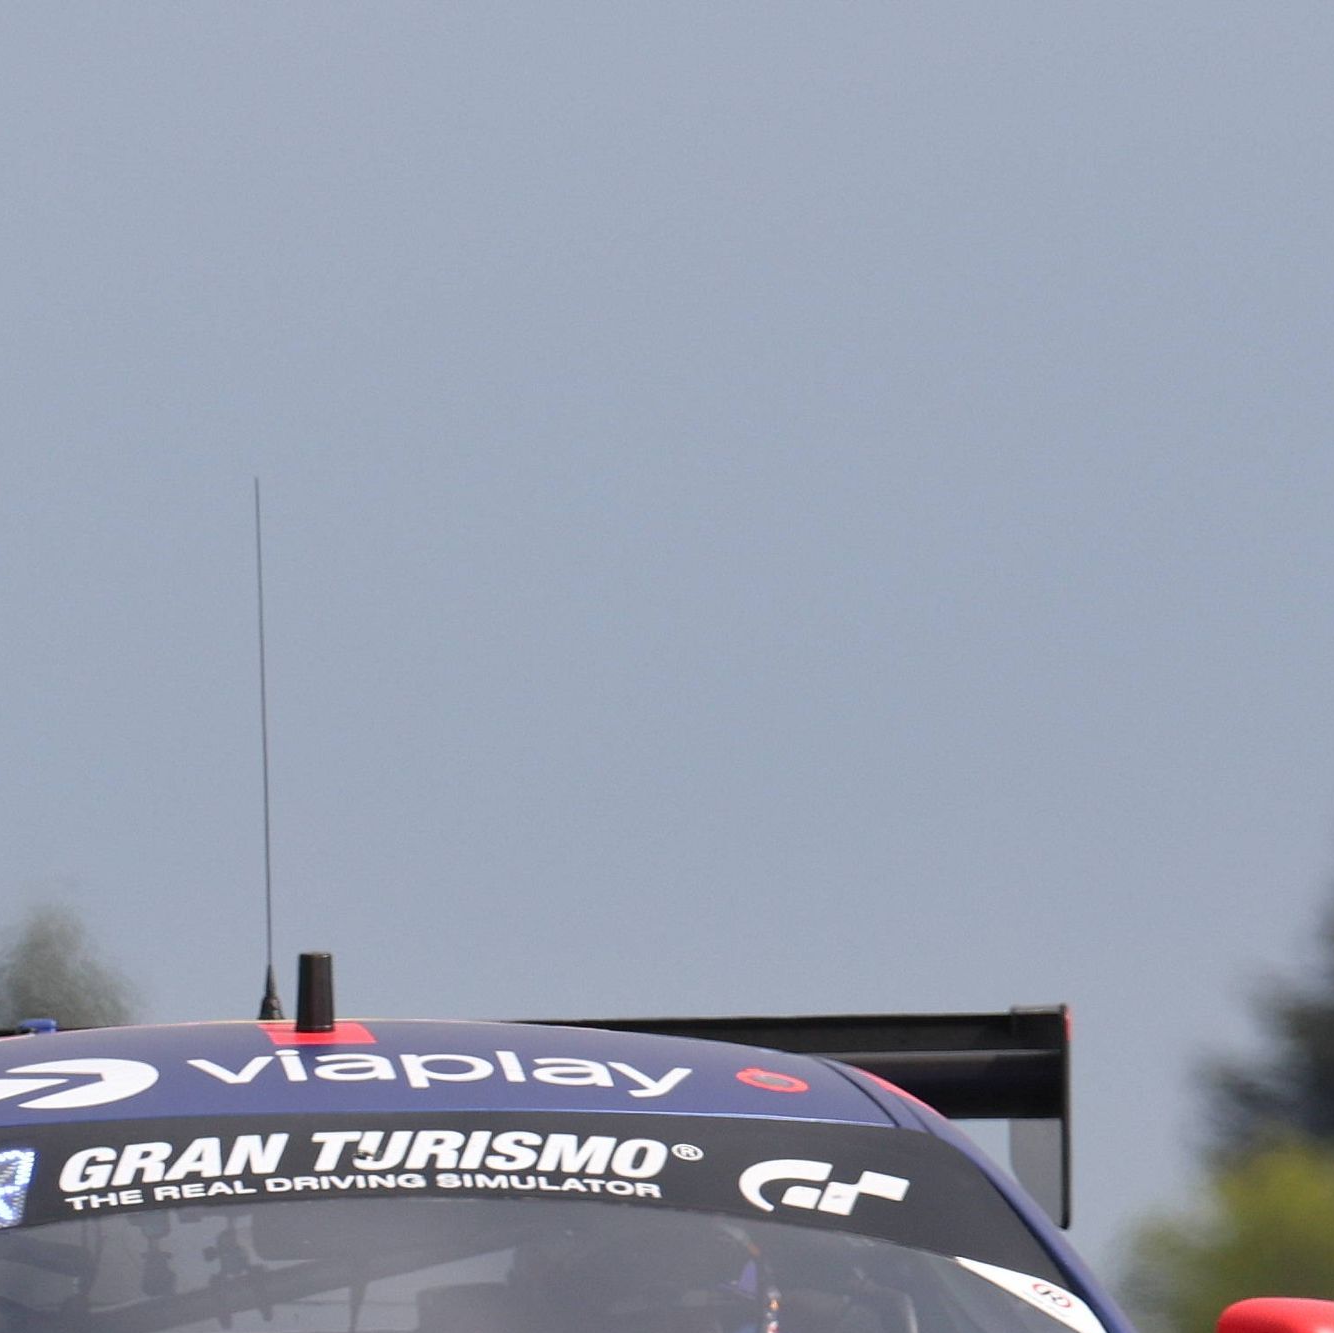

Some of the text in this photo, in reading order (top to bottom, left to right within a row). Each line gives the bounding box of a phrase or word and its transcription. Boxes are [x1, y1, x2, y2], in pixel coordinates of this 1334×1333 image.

[186, 1047, 693, 1099] viaplay
[59, 1129, 668, 1193] GRAN TURISMO
[65, 1172, 663, 1211] THE REAL DRIVING SIMULATOR
